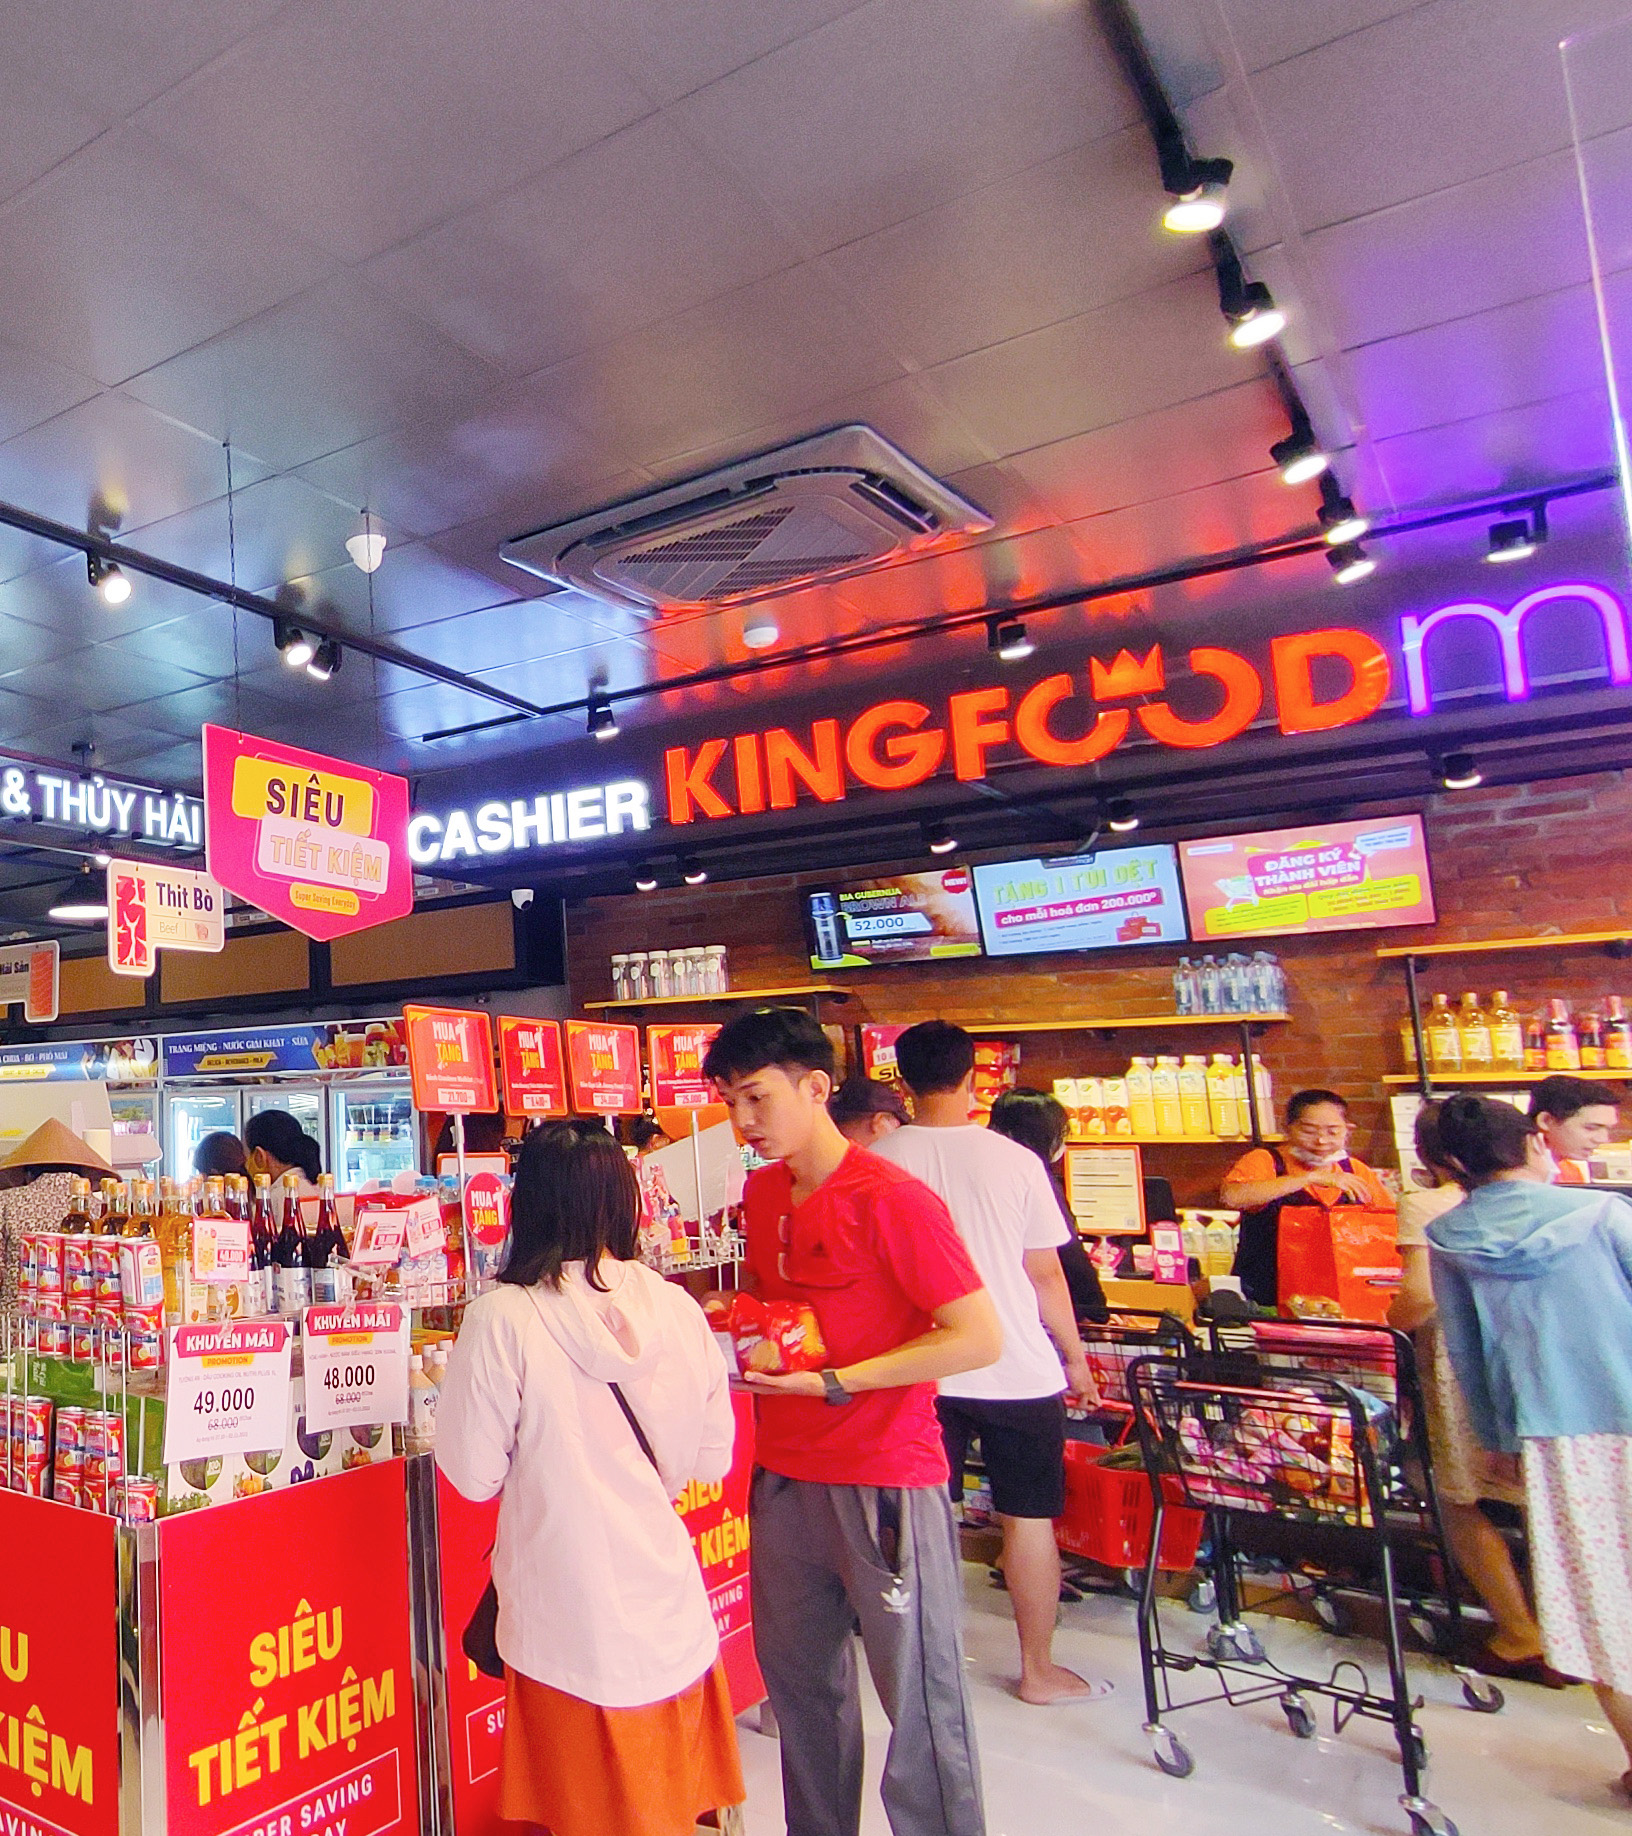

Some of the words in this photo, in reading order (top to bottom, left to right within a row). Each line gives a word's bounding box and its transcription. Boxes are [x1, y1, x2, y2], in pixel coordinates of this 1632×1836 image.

[2, 771, 32, 816] &
[36, 776, 136, 830] THỦY
[144, 792, 201, 844] HẢI
[267, 774, 344, 827] SIÊU
[407, 781, 650, 863] CASHIER
[270, 828, 323, 868] TIẾT
[327, 842, 383, 886] KIỆM
[1264, 855, 1315, 872] ĐĂNG
[1318, 847, 1343, 863] KÝ
[1255, 868, 1317, 887] THÀNH
[1318, 859, 1361, 877] VIÊN
[155, 882, 190, 916] Thịt
[193, 888, 213, 911] Bò
[840, 897, 898, 912] BROWN
[1001, 913, 1022, 925] cho
[1076, 902, 1100, 914] đơn
[159, 921, 179, 934] Beef
[855, 917, 904, 931] 52.000
[432, 1021, 456, 1041] MUA
[518, 1031, 535, 1049] MUA
[435, 1040, 462, 1063] TẶNG
[588, 1034, 608, 1051] MUA
[673, 1036, 693, 1051] MUA
[520, 1048, 540, 1068] TẶNG
[590, 1050, 613, 1069] TẶNG
[674, 1050, 698, 1069] TẶNG
[471, 1190, 493, 1207] MUA
[472, 1205, 497, 1225] TẶNG
[364, 1310, 391, 1328] MÃI
[245, 1328, 275, 1348] MÃI
[207, 1356, 248, 1365] PROMOTION
[324, 1365, 375, 1390] 48.000
[193, 1387, 255, 1415] 49.000
[208, 1416, 239, 1431] 68.000
[708, 1585, 744, 1614] AVING
[249, 1598, 343, 1688] SIÊU
[188, 1697, 288, 1807] TIẾT
[297, 1665, 396, 1760] KIỆM
[300, 1773, 373, 1829] SAVING
